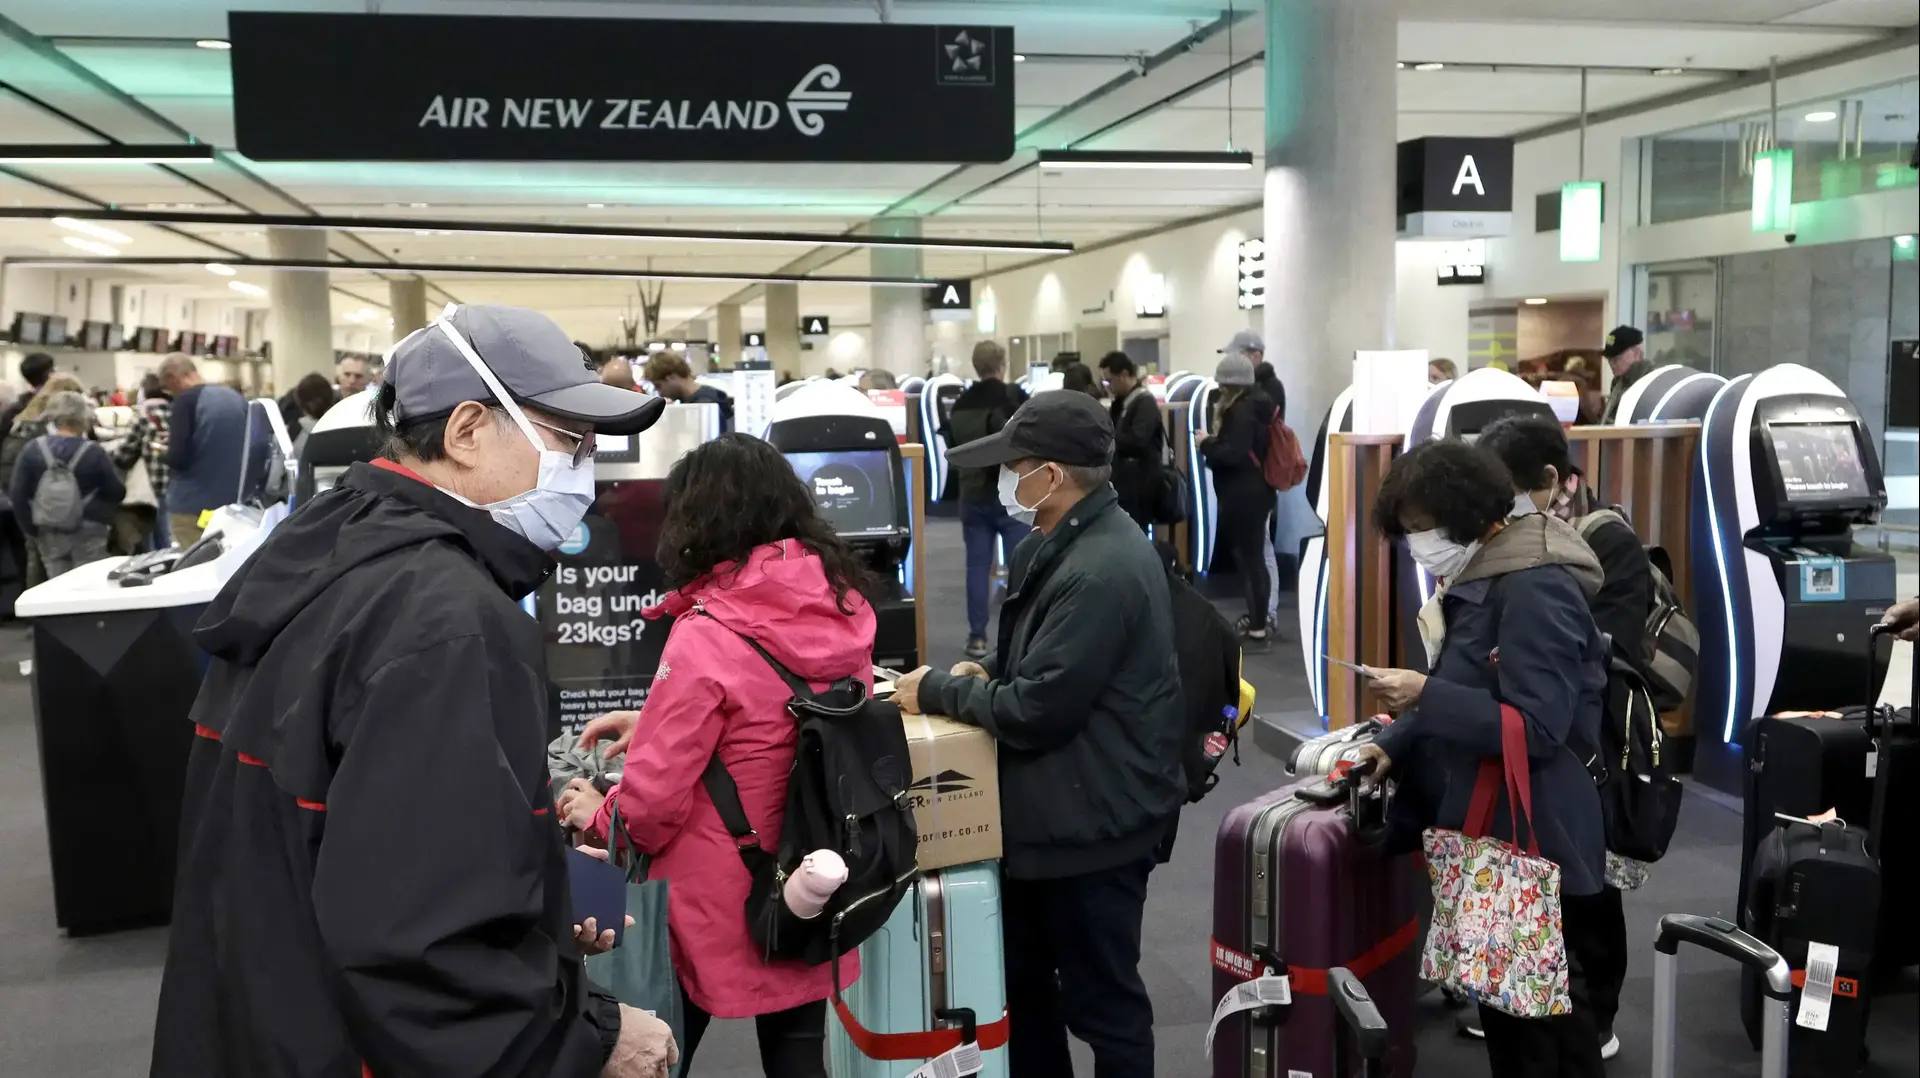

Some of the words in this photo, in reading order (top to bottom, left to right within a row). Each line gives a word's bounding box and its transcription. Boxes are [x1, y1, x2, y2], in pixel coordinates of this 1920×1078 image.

[418, 94, 490, 128] AIR
[501, 97, 593, 129] NEW
[599, 99, 780, 130] ZEALAND
[1451, 154, 1486, 196] A
[943, 284, 960, 304] A
[810, 319, 823, 333] A
[556, 563, 577, 584] Is
[584, 566, 638, 587] your
[556, 592, 602, 617] bag
[557, 619, 645, 646] 23kgs?
[560, 690, 587, 699] Check
[589, 689, 606, 698] that
[607, 689, 626, 698] your
[628, 688, 645, 696] bag
[560, 702, 586, 711] heavy
[587, 701, 597, 709] to
[560, 713, 576, 722] any
[948, 790, 984, 802] ZEALAND
[1215, 959, 1229, 969] LION
[1231, 965, 1253, 979] TRAVEL
